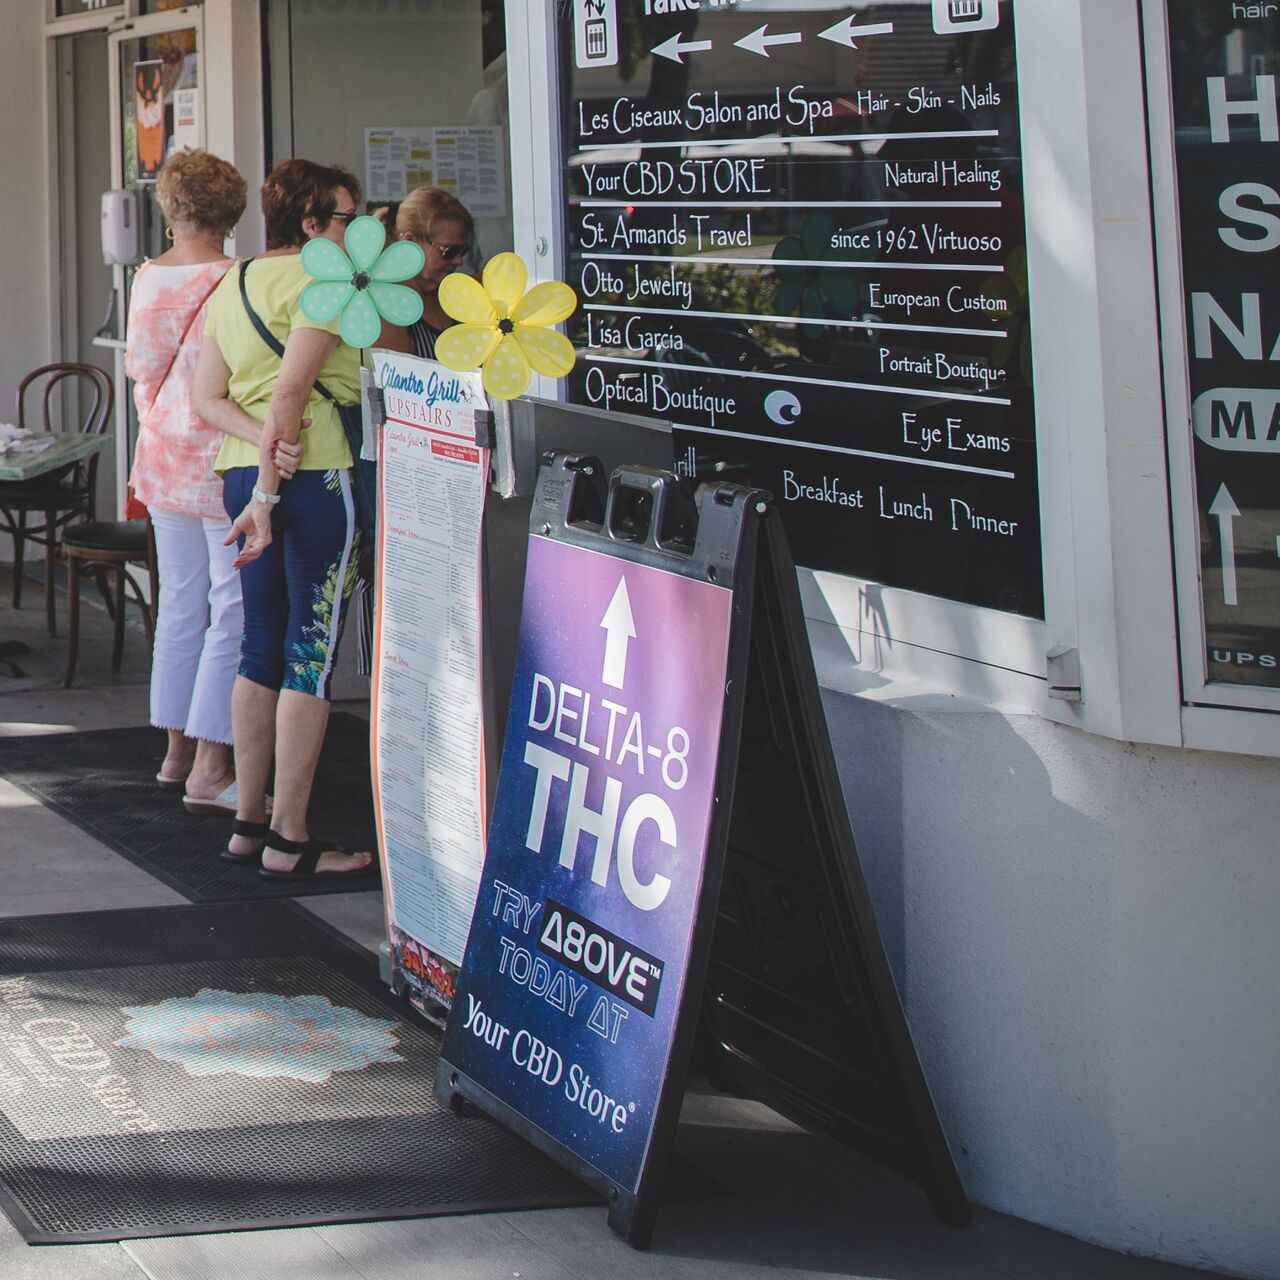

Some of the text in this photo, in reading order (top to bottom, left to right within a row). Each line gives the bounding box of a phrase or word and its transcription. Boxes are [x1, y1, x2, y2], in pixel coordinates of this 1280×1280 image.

[1232, 1, 1278, 19] hair
[579, 85, 833, 136] Les Ciseaux Salon and Spa
[857, 89, 889, 114] Hair
[906, 87, 942, 114] Skin
[961, 82, 1001, 110] Nails
[581, 158, 771, 196] Your CBD STORE
[884, 160, 1001, 191] Natural Healing
[580, 213, 752, 252] St. Armands Travel
[830, 223, 1002, 254] since 1962 Virtuoso
[581, 262, 692, 310] Otto Jewelry
[869, 283, 1008, 316] European Custom
[587, 313, 684, 352] Lisa Garcia
[381, 362, 461, 407] Cilantro Grill
[880, 348, 1006, 390] Portrait Boutique
[388, 396, 452, 428] UPSTAIRS
[586, 367, 737, 427] Optical Boutique
[902, 412, 1010, 453] Eye Exams
[674, 446, 696, 478] rill
[783, 470, 863, 508] Breakfast
[879, 486, 933, 521] Lunch
[528, 673, 690, 790] DELTA-8
[524, 741, 678, 911] THC
[492, 879, 541, 935] TRY
[498, 936, 588, 1018] TODAY
[587, 995, 629, 1044] AT
[463, 993, 510, 1051] Your
[512, 1030, 563, 1086] CBD
